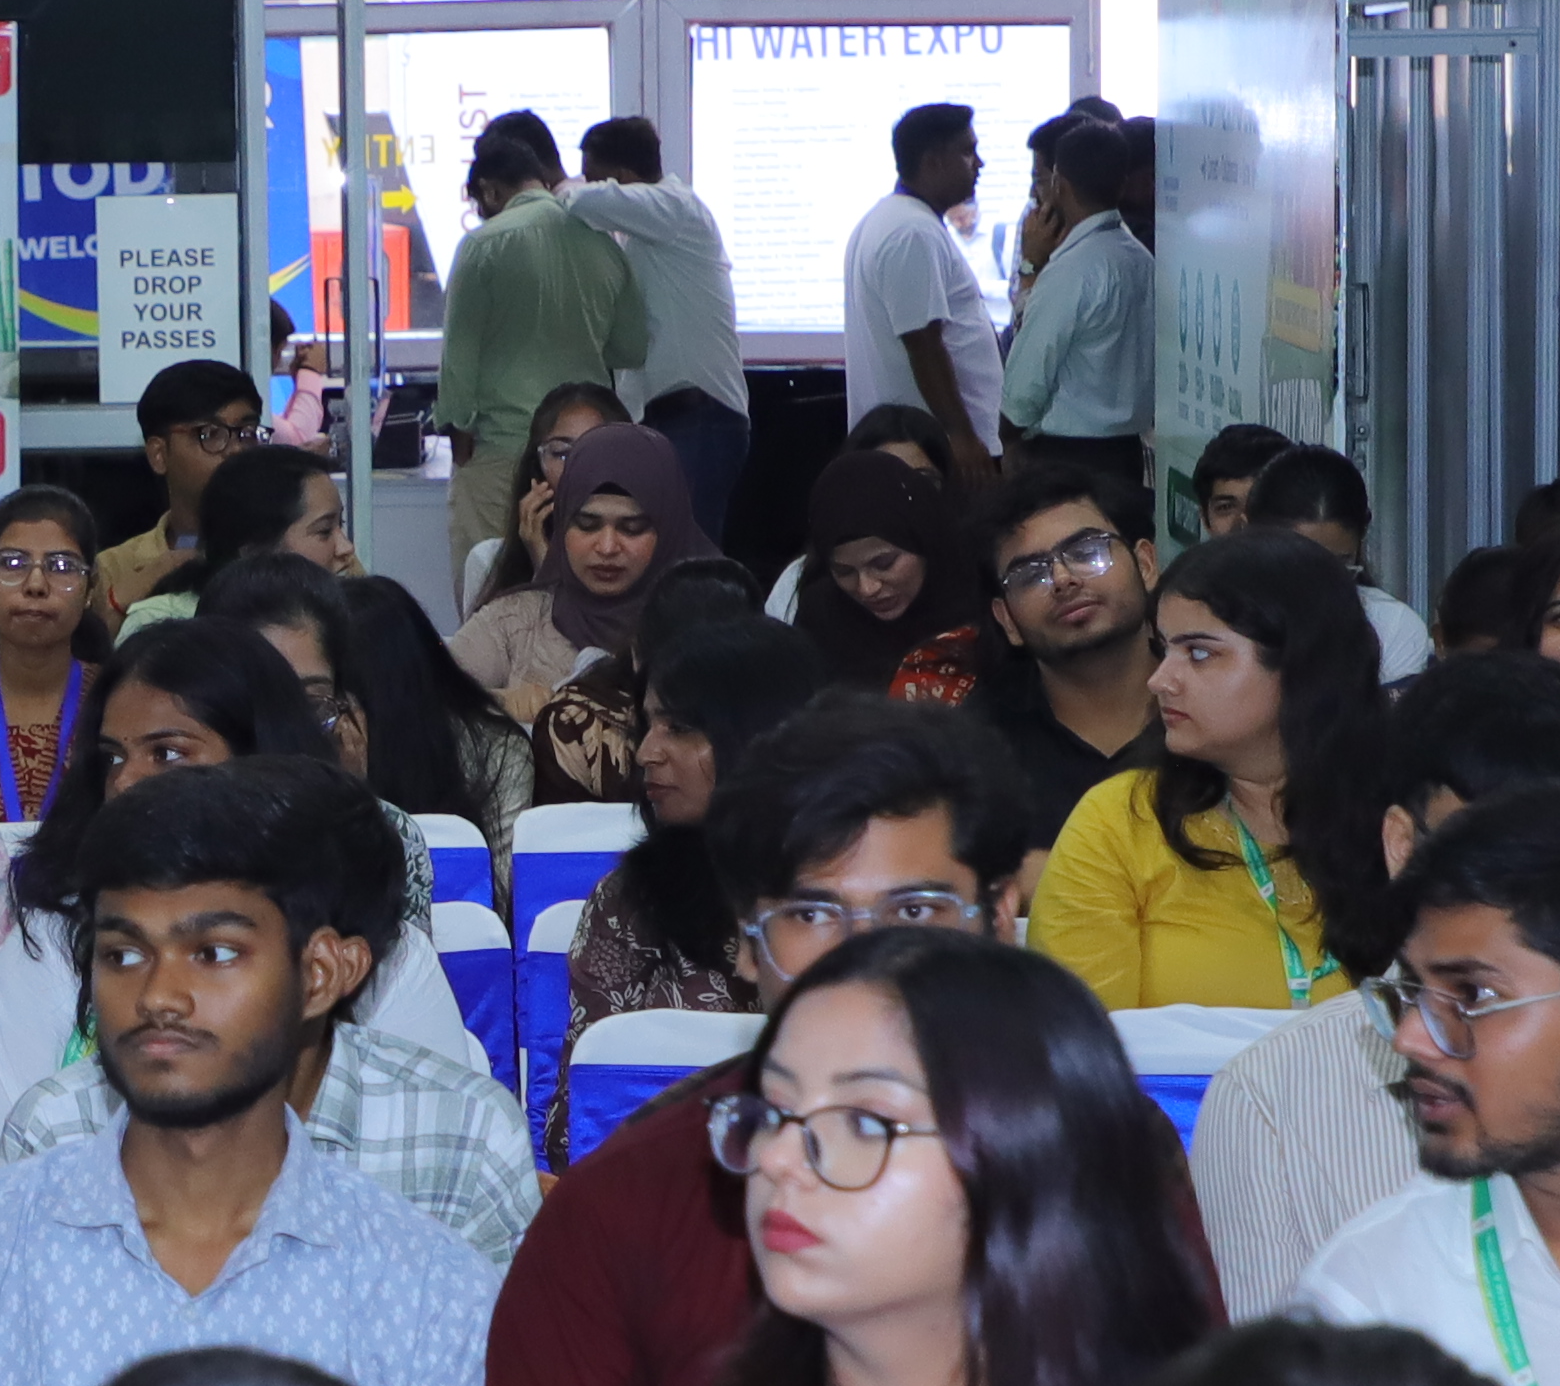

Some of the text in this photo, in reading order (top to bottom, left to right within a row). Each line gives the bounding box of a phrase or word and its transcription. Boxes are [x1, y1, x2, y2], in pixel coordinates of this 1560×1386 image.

[750, 25, 887, 59] WATER
[903, 25, 1004, 56] EXPO
[120, 248, 215, 269] PLEASE
[134, 276, 202, 295] DROP
[133, 303, 203, 322] YOUR
[121, 329, 216, 350] PASSES
